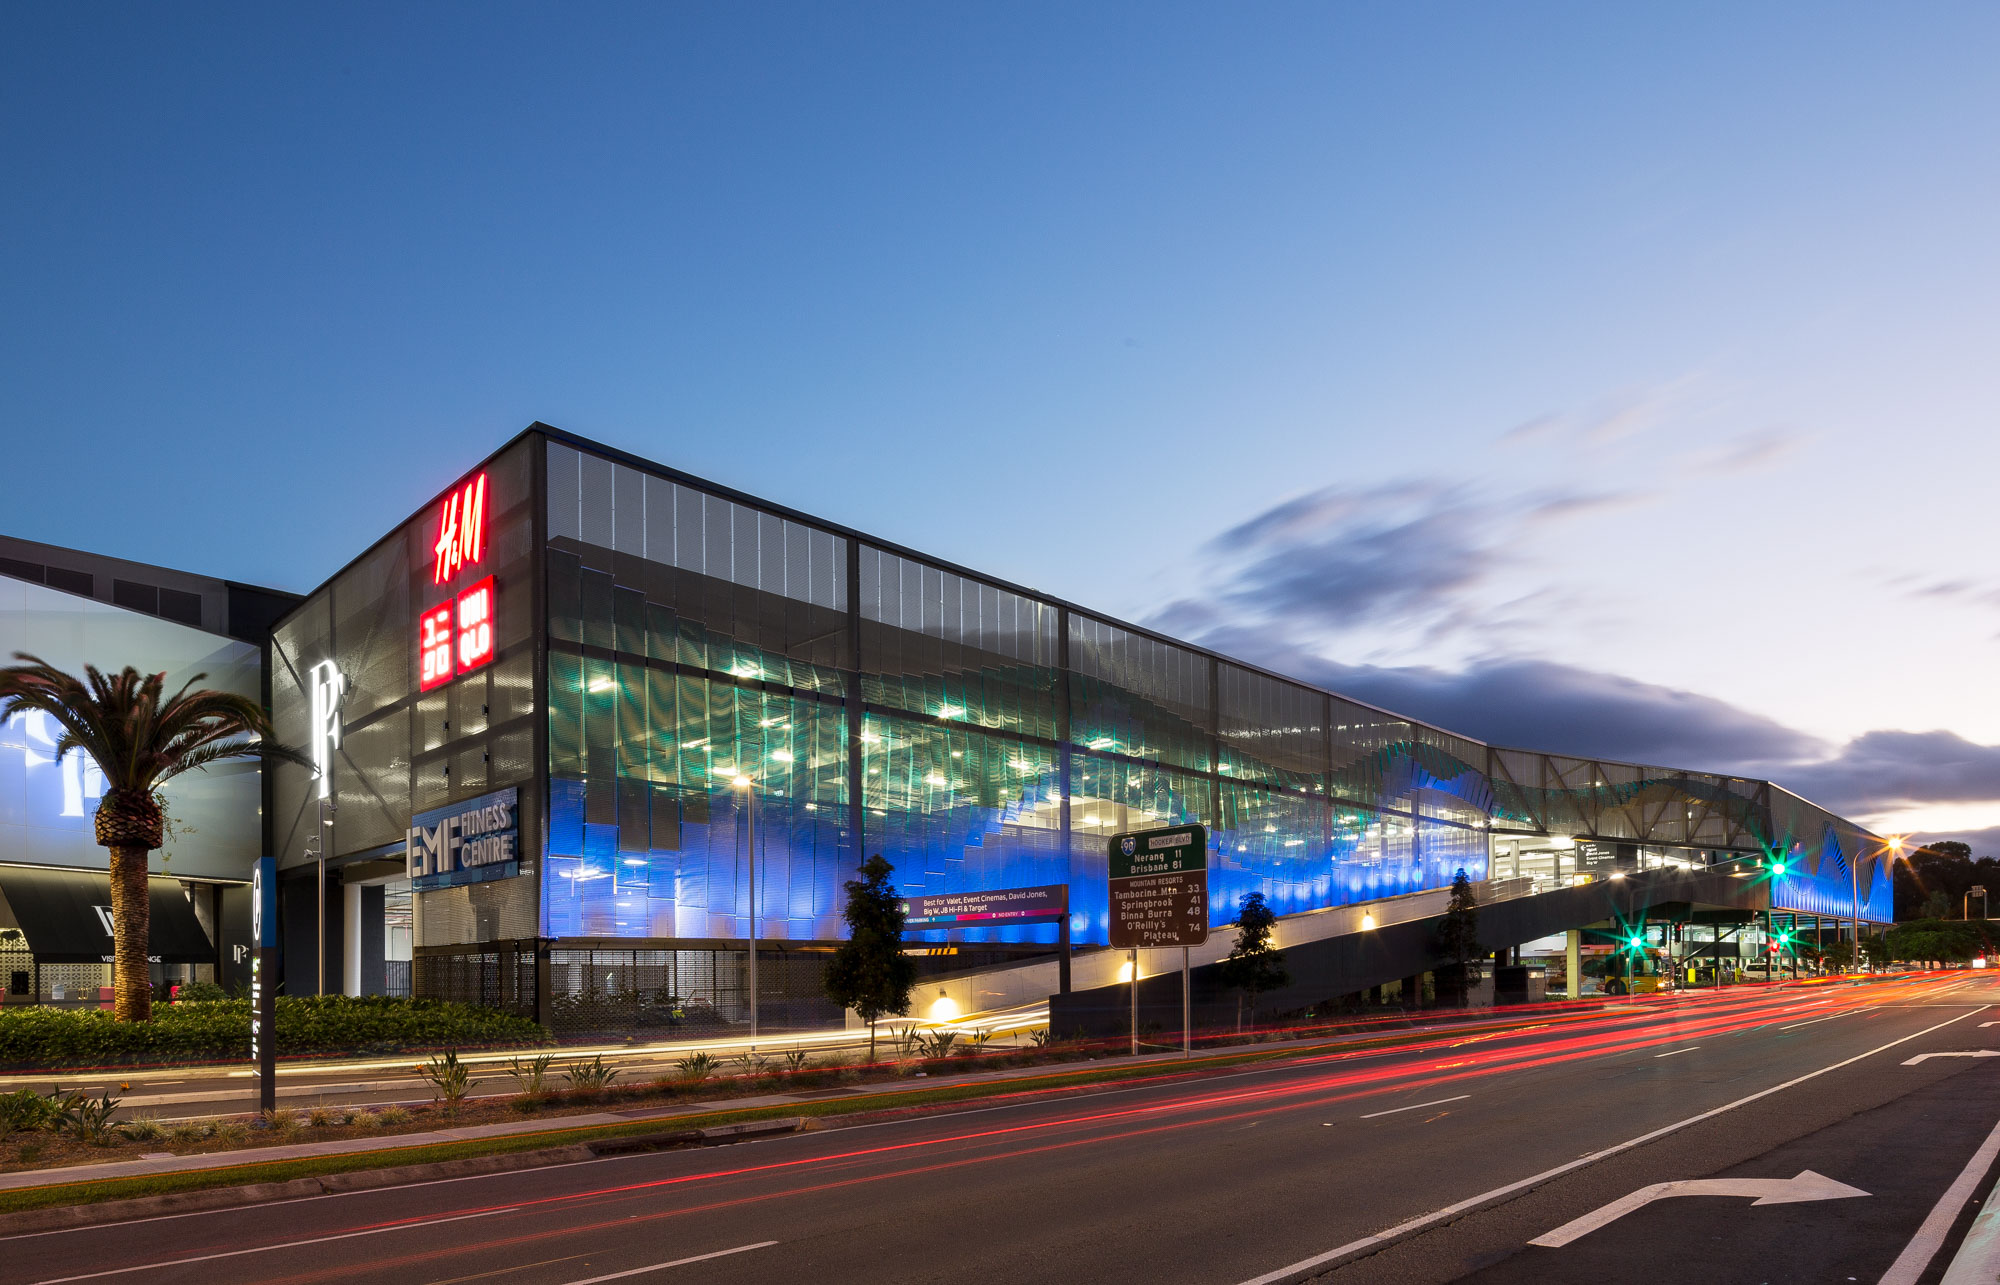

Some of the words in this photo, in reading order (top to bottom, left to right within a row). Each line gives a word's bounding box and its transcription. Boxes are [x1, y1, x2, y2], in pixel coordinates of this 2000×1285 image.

[435, 473, 486, 585] H&M
[460, 588, 487, 629] UNI
[460, 622, 490, 667] QLO
[461, 802, 510, 837] FITNESS
[406, 816, 460, 878] EMF
[461, 834, 513, 868] CENTRE
[1134, 852, 1164, 863] Nerang
[1175, 849, 1182, 858] 11
[1130, 862, 1169, 874] Brisbane
[1172, 860, 1182, 869] 81
[1129, 878, 1157, 888] MOUNTAIN
[1157, 876, 1184, 886] RESORTS
[923, 899, 936, 907] Best
[936, 898, 945, 906] for
[946, 897, 963, 906] Valet,
[963, 895, 980, 904] Event
[981, 894, 1008, 903] Cinemas,
[1009, 892, 1026, 900] David
[1027, 890, 1048, 899] Jones,
[1114, 889, 1157, 900] Tamborine
[1160, 886, 1178, 896] Mtn
[1187, 884, 1200, 893] 33
[923, 908, 933, 916] Big
[940, 906, 948, 914] JB
[949, 905, 963, 913] Hi-Fi
[969, 904, 987, 912] Target
[1121, 898, 1173, 911] Springbrook
[1190, 896, 1201, 904] 41
[1120, 911, 1144, 920] Binna
[1147, 909, 1173, 919] Burra
[1187, 906, 1201, 915] 48
[1127, 920, 1166, 930] O'Reilly's
[1188, 923, 1201, 932] 74
[1144, 931, 1177, 941] Plateau
